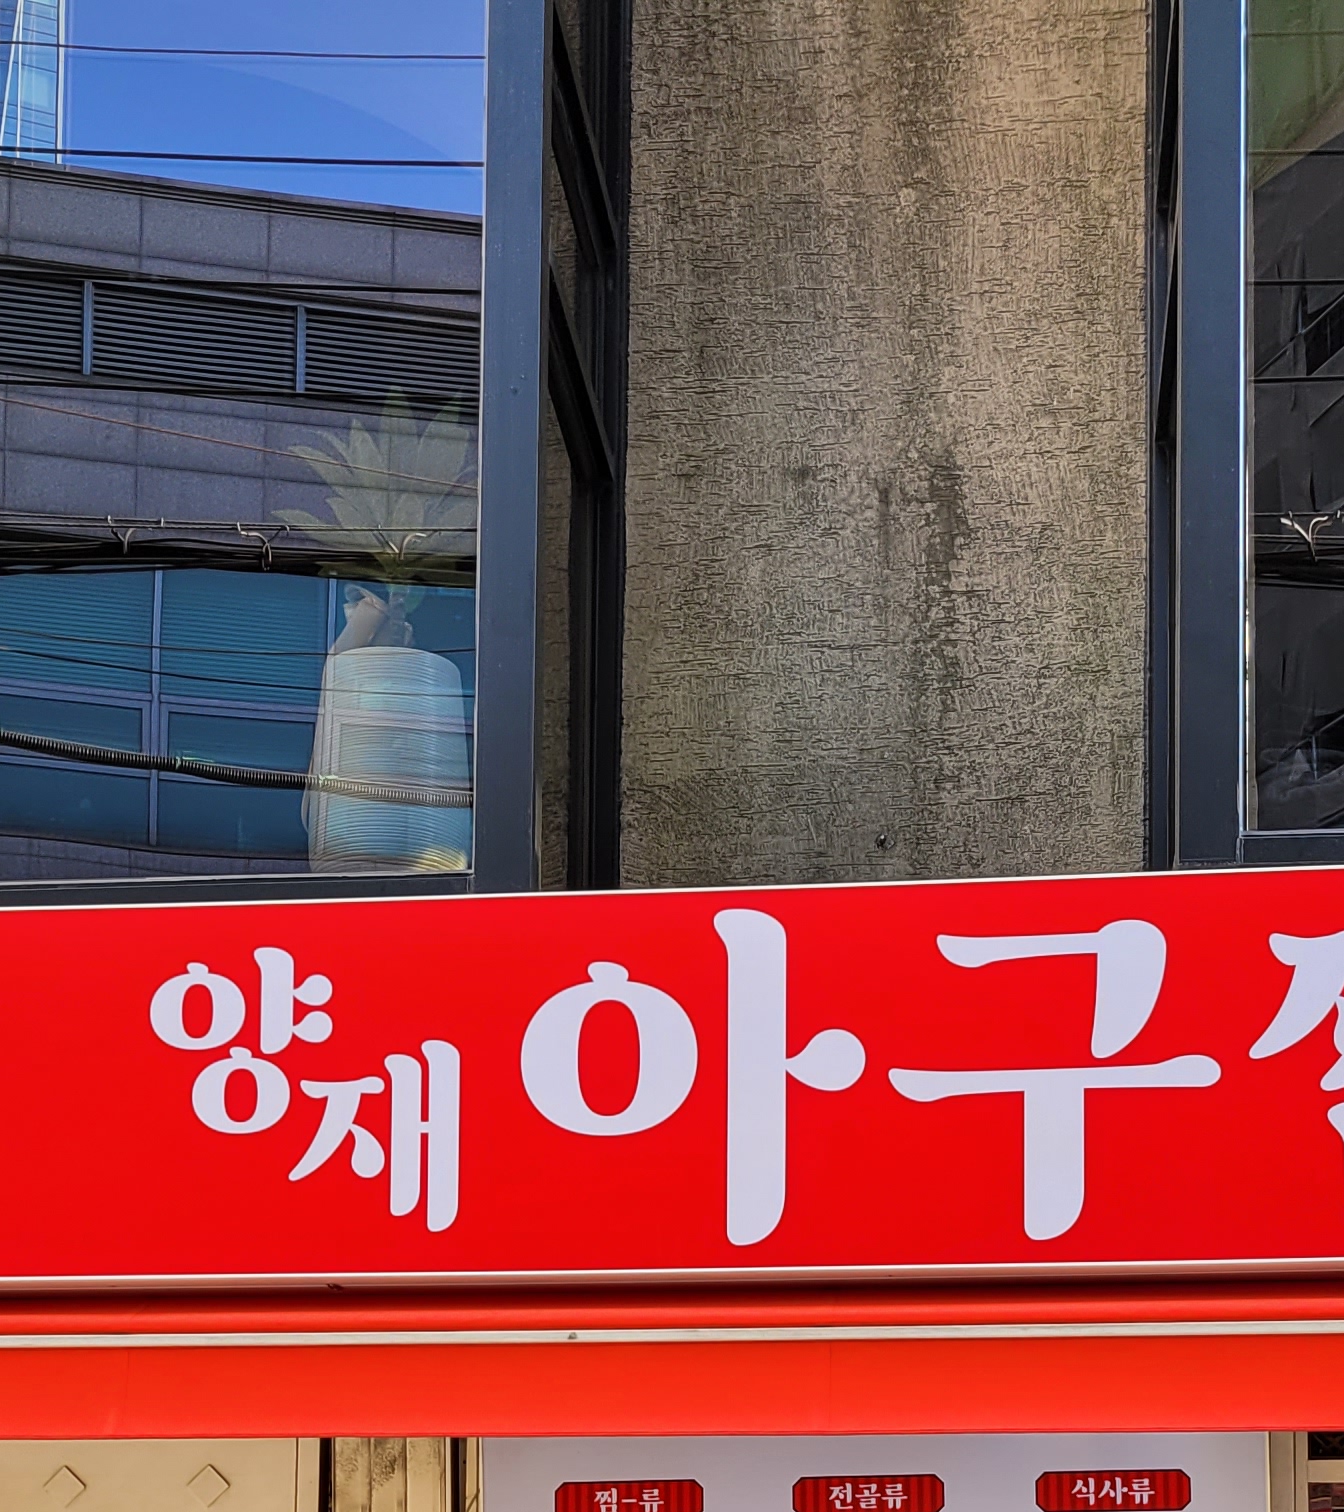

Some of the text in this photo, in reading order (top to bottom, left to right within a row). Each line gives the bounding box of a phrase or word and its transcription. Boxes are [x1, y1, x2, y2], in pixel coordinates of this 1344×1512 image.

[150, 947, 460, 1232] 양재
[829, 1479, 908, 1509] 전골류
[1072, 1476, 1156, 1506] 식사류
